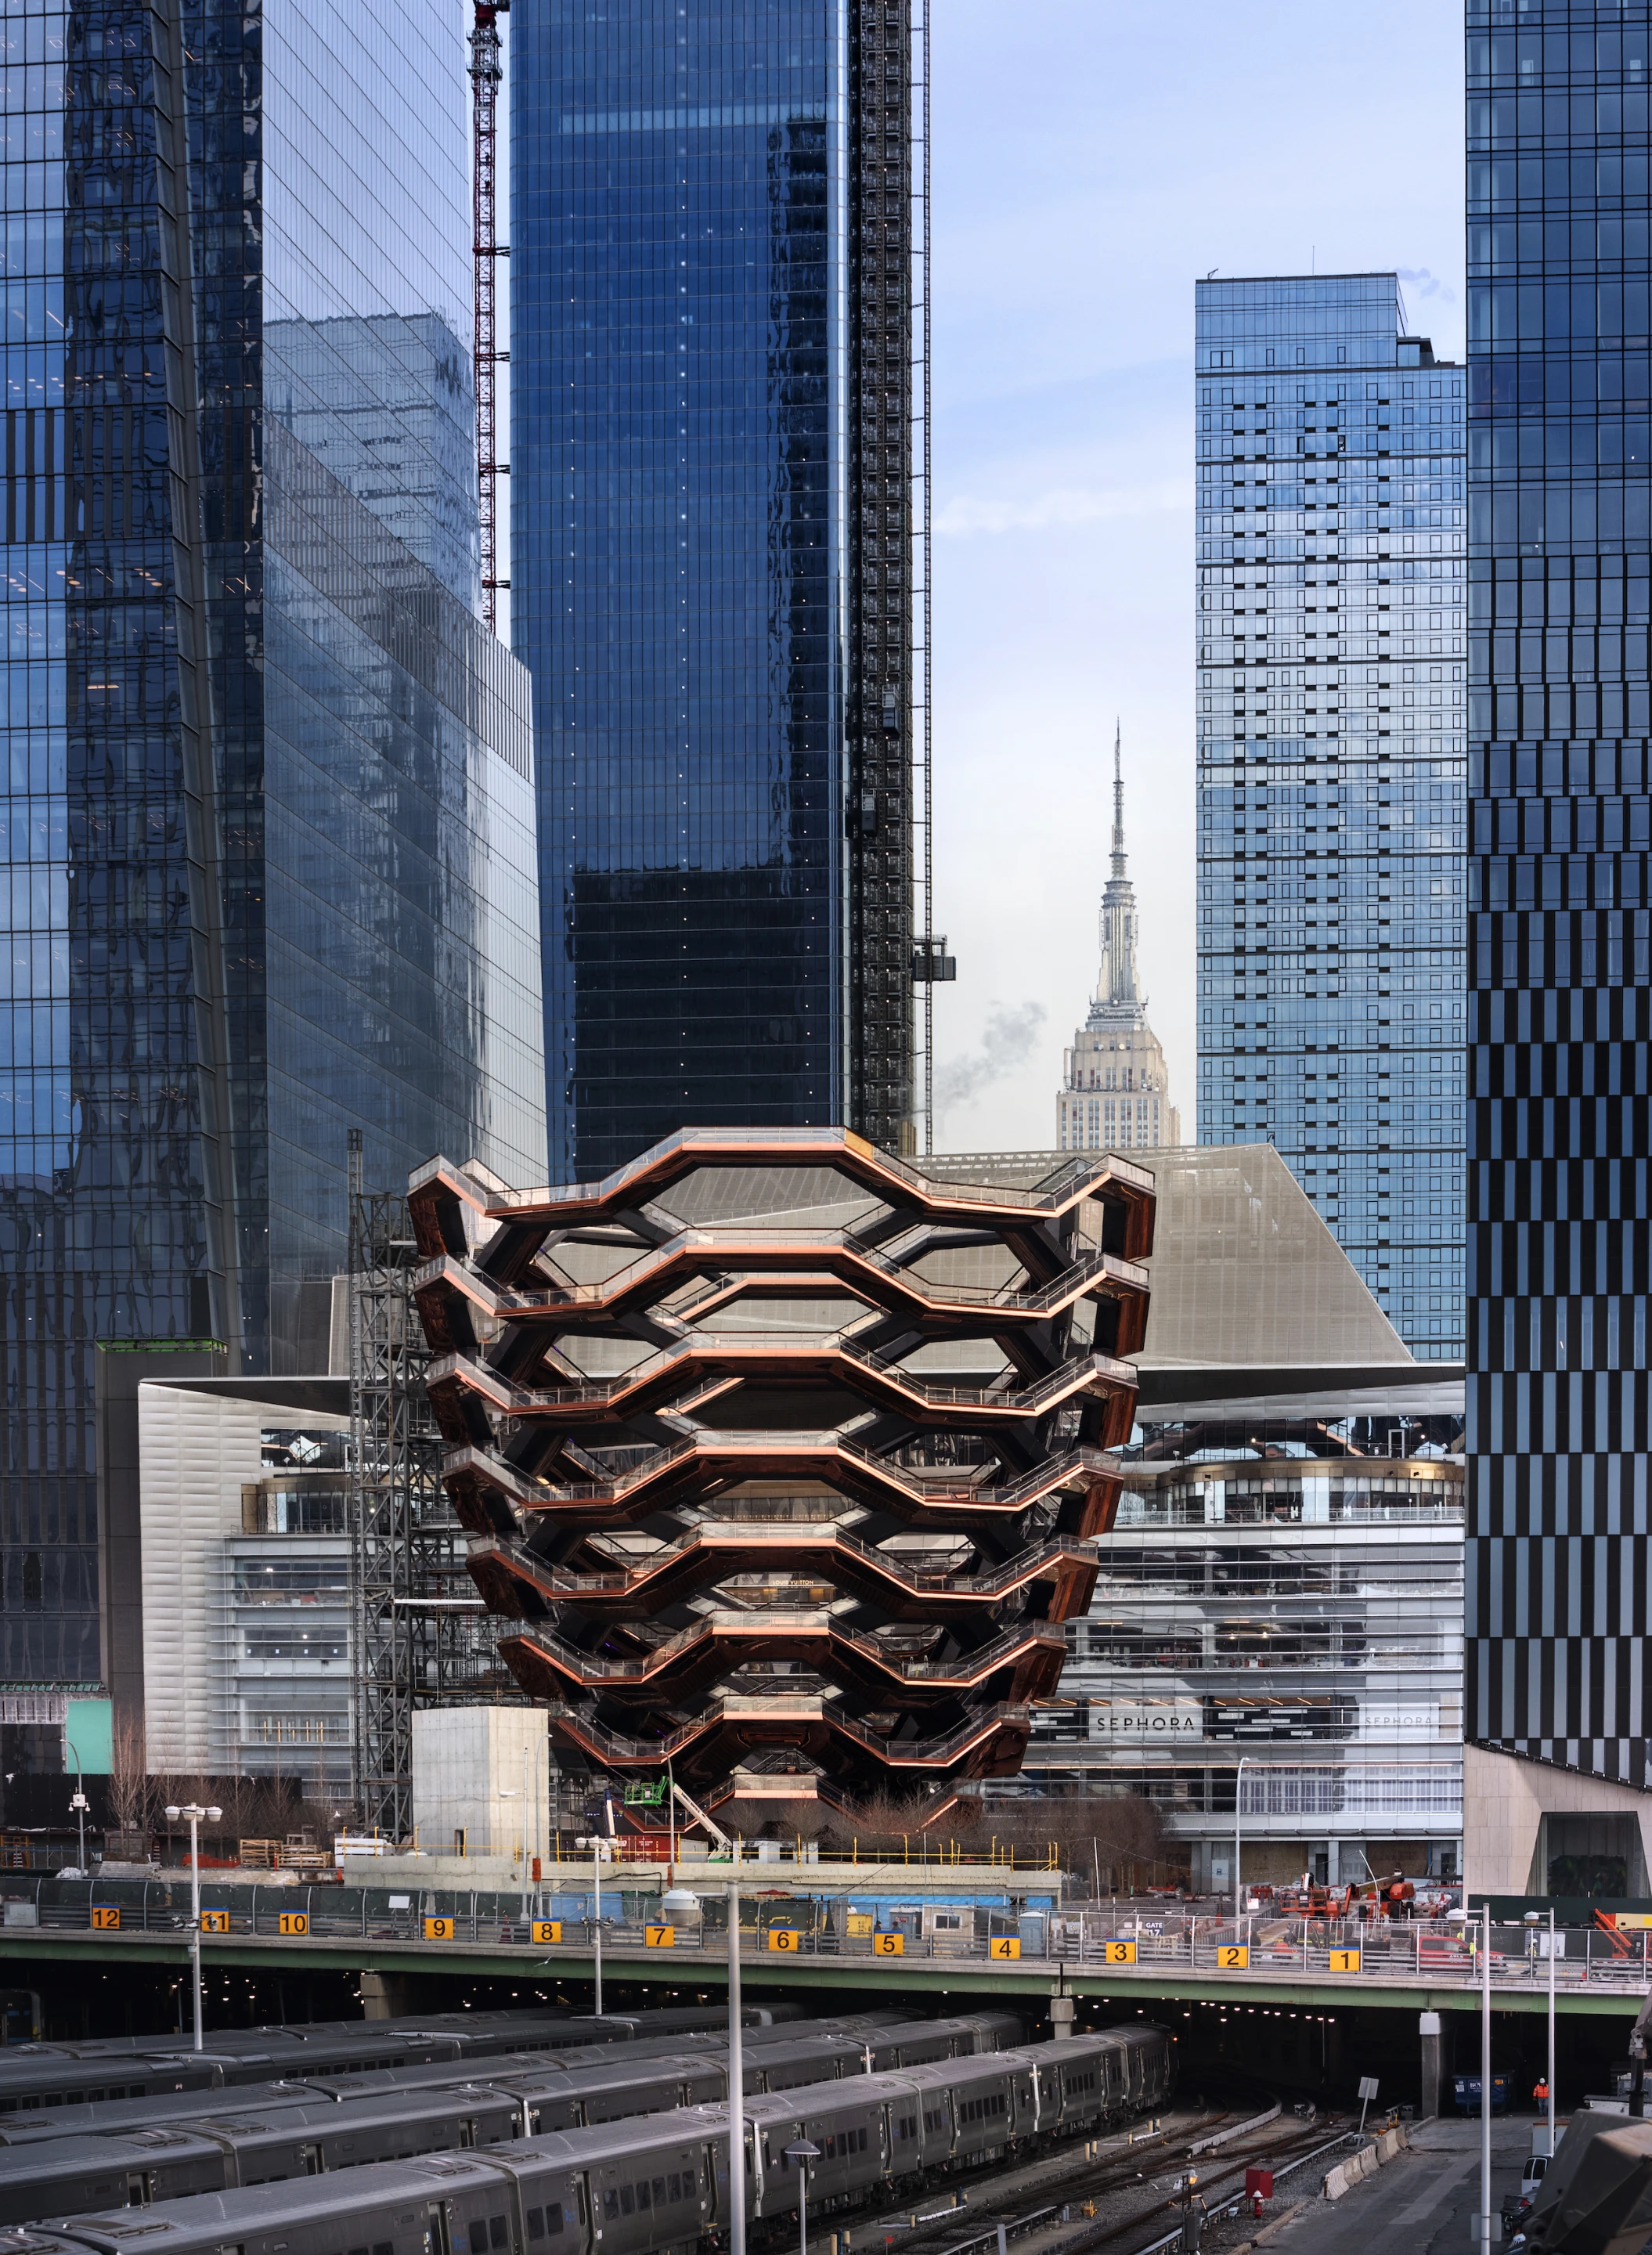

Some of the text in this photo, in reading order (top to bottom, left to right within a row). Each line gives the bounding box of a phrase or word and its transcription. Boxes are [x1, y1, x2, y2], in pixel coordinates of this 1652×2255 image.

[1097, 1716, 1195, 1731] SEPHORA
[1365, 1716, 1432, 1728] SEPHORA
[94, 1910, 119, 1927] 12
[204, 1913, 226, 1930] 11
[281, 1915, 307, 1932] 10
[433, 1920, 445, 1937] 9
[541, 1923, 554, 1942] 8
[654, 1928, 665, 1945] 7
[777, 1932, 789, 1949] 6
[882, 1935, 895, 1953] 5
[999, 1939, 1012, 1957] 4
[1114, 1943, 1127, 1961] 3
[1227, 1948, 1239, 1966] 2
[1340, 1953, 1349, 1970] 1
